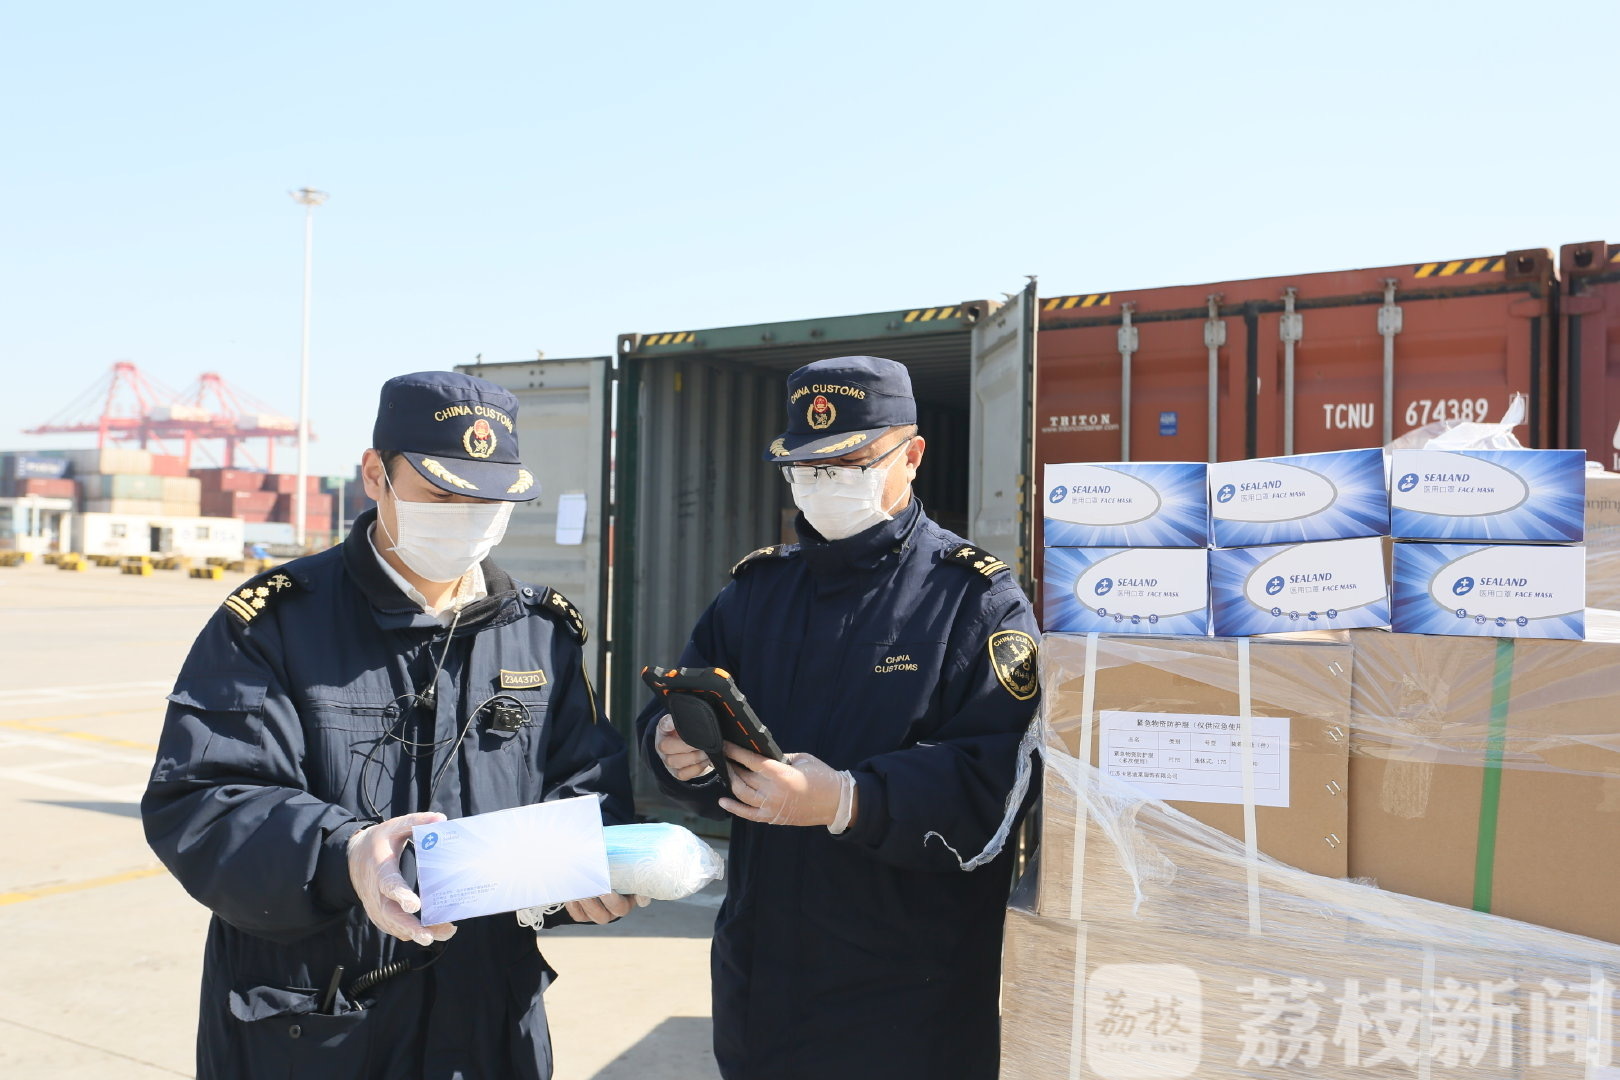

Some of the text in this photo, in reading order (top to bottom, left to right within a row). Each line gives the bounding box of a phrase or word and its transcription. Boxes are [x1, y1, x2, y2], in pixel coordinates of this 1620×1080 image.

[790, 384, 866, 405] CHINA CUSTOMS
[434, 405, 473, 422] CHINA
[1323, 398, 1489, 430] TCNU 674389
[1050, 413, 1111, 427] TRITON
[1423, 473, 1470, 483] SEALAND
[1071, 485, 1111, 494] SEALAND
[1240, 480, 1282, 491] SEALAND
[1423, 485, 1455, 494] 医用口罩
[1457, 486, 1476, 494] FACE
[1117, 578, 1158, 588] SEALAND
[1289, 573, 1332, 584] SEALAND
[1479, 577, 1528, 587] SEALAND
[1340, 583, 1357, 591] MASK
[1479, 589, 1512, 598] 医用口罩
[1514, 591, 1532, 599] FACE
[885, 654, 911, 664] CHINA
[874, 663, 919, 673] CUSTOMS
[504, 674, 540, 684] 2344370
